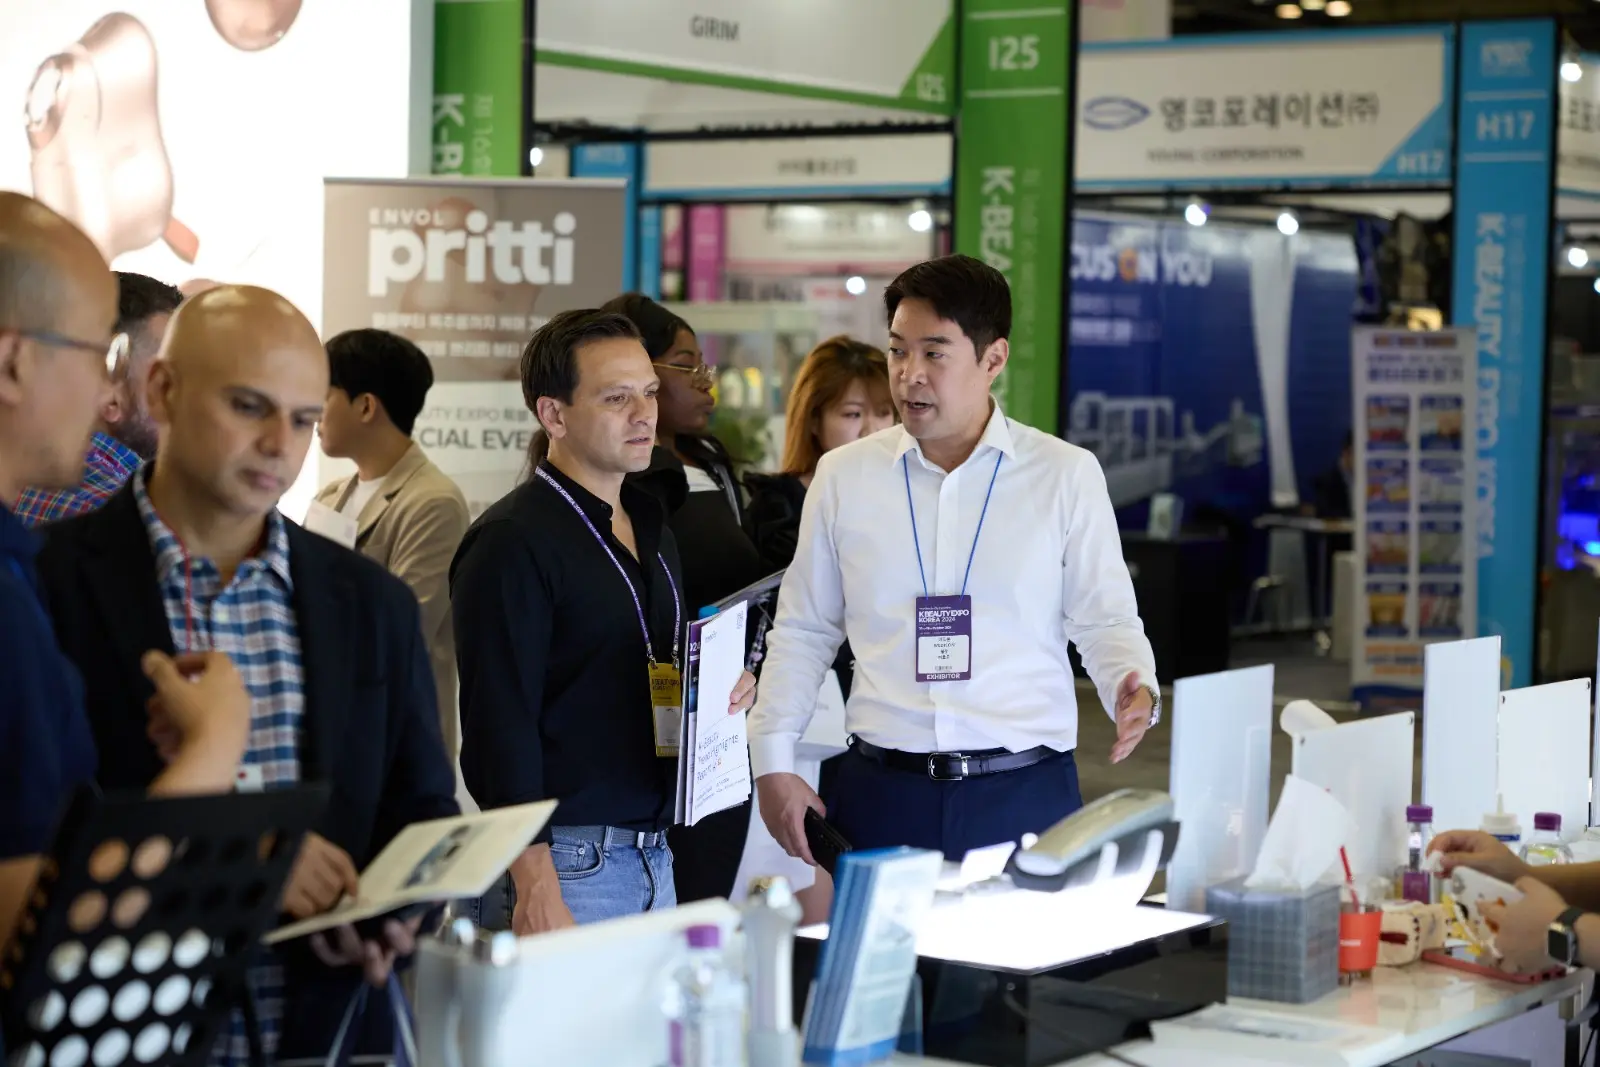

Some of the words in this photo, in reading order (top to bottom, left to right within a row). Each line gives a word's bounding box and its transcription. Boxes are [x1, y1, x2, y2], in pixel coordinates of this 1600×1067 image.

[689, 14, 740, 41] GIRIM
[1477, 112, 1535, 141] H17
[1397, 151, 1445, 174] H17
[369, 208, 445, 226] ENVOL
[981, 165, 1016, 286] K-BEA
[368, 211, 577, 297] pritti
[418, 427, 475, 450] CIAL
[483, 429, 530, 450] EVE
